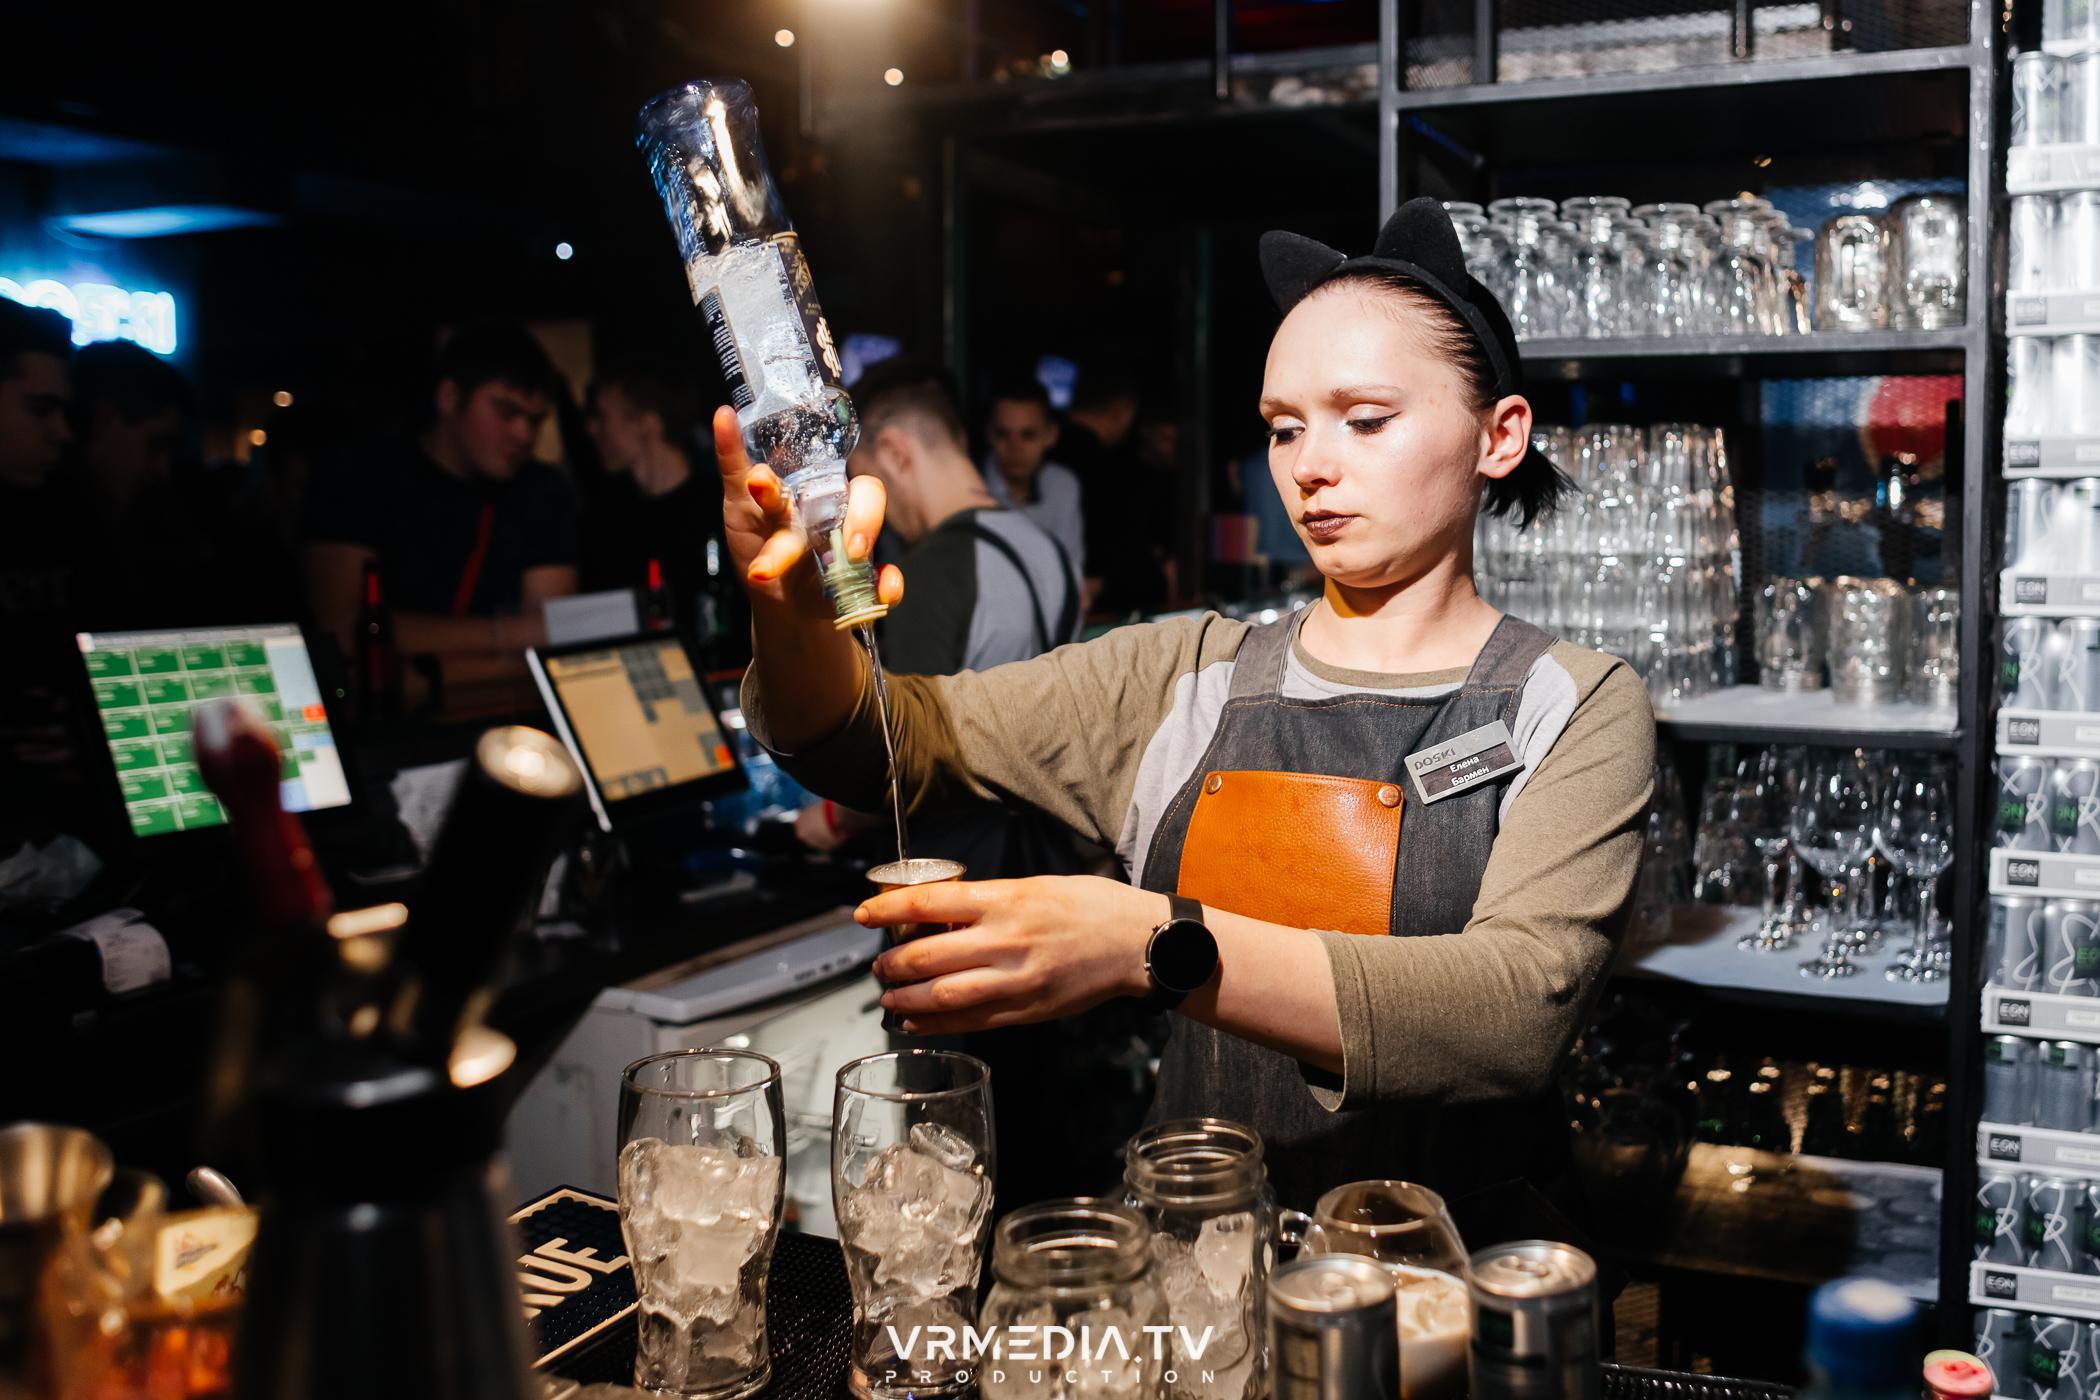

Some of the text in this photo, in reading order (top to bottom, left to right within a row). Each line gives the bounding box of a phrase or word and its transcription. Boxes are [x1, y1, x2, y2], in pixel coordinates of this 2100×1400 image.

[1414, 747, 1456, 770] DOSKI
[1449, 756, 1480, 773] Елена
[1451, 766, 1490, 787] Бармен
[517, 1237, 631, 1319] UE
